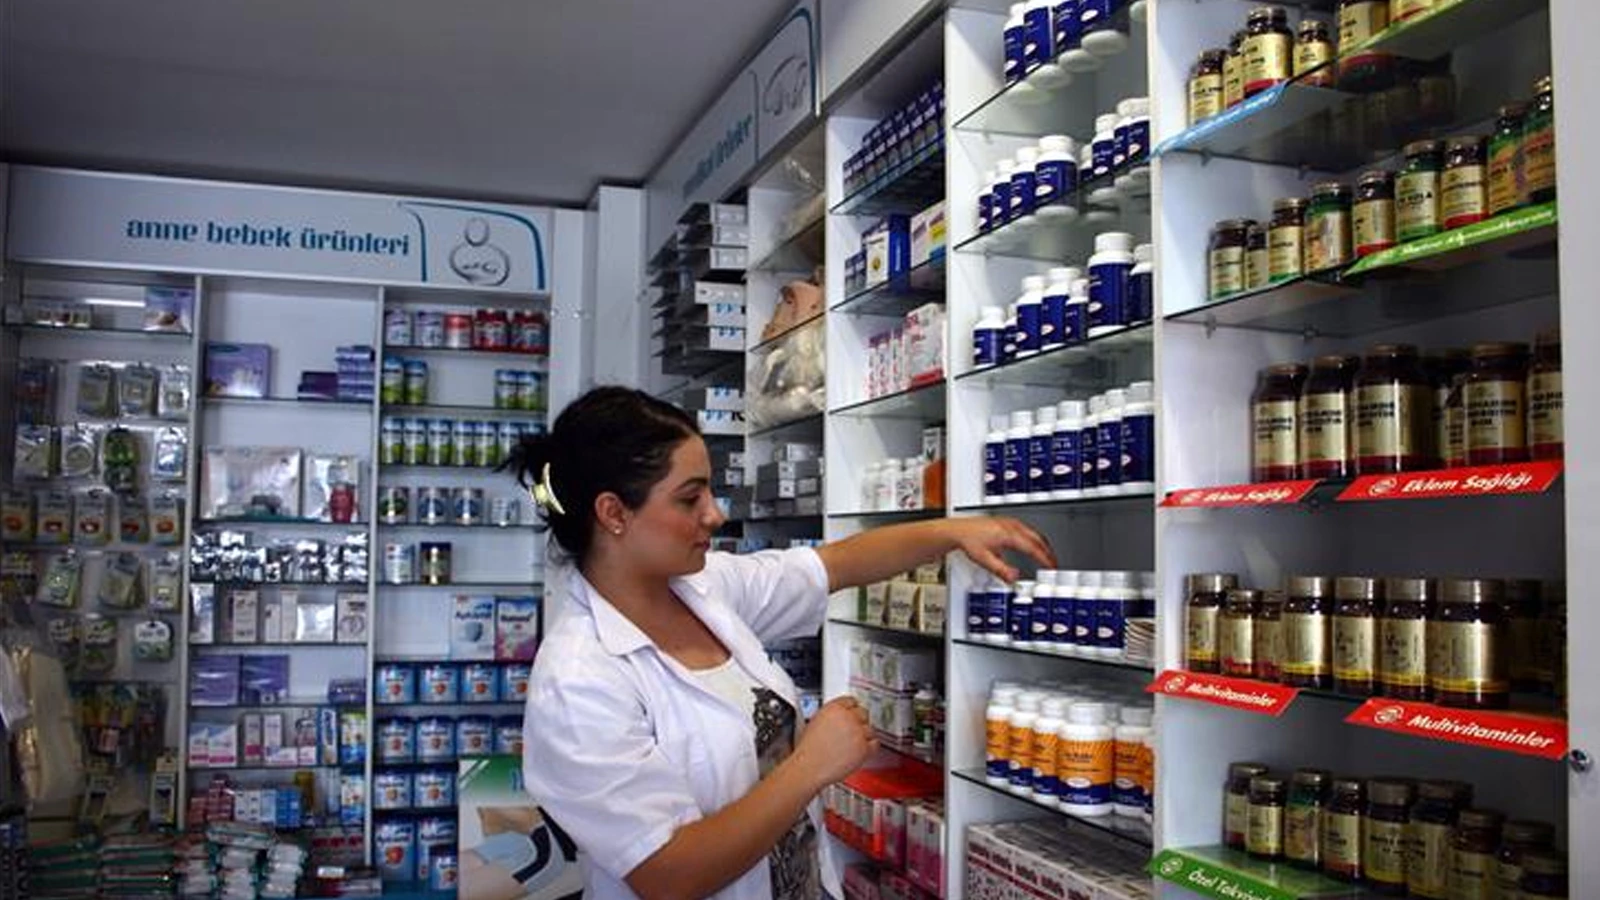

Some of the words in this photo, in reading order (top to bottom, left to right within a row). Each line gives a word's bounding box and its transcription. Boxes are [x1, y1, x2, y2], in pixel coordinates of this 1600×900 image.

[126, 218, 198, 242] anne
[206, 220, 291, 249] bebek
[299, 227, 409, 256] ürünleri
[1402, 476, 1458, 492] Eklem
[1462, 471, 1533, 491] Sağlığı
[1184, 681, 1279, 707] Multivitaminler
[1408, 713, 1555, 749] Multivitaminler
